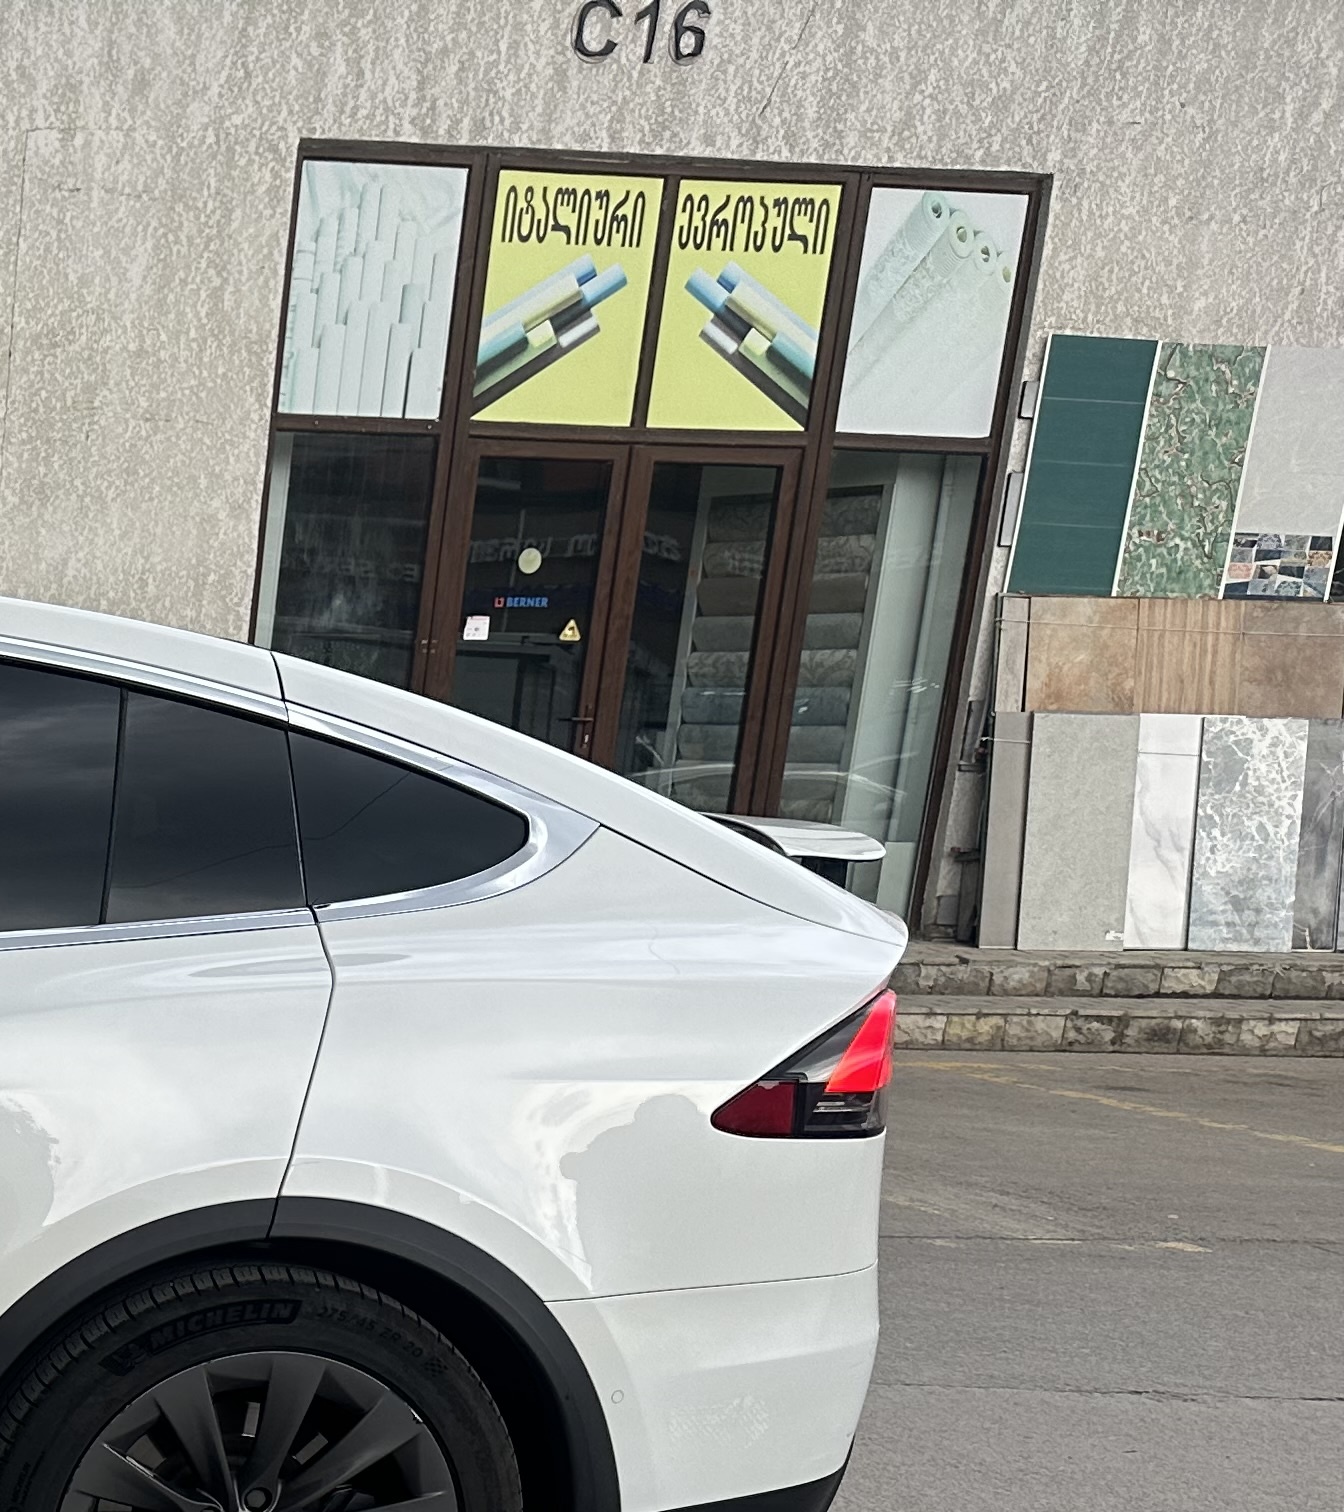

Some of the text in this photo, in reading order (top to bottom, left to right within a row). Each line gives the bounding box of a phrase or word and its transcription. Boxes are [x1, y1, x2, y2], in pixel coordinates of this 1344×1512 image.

[573, 0, 711, 64] C16
[501, 185, 830, 255] იტალიური ევროპული
[505, 597, 549, 608] BERNER
[150, 1302, 294, 1350] MICHELIN
